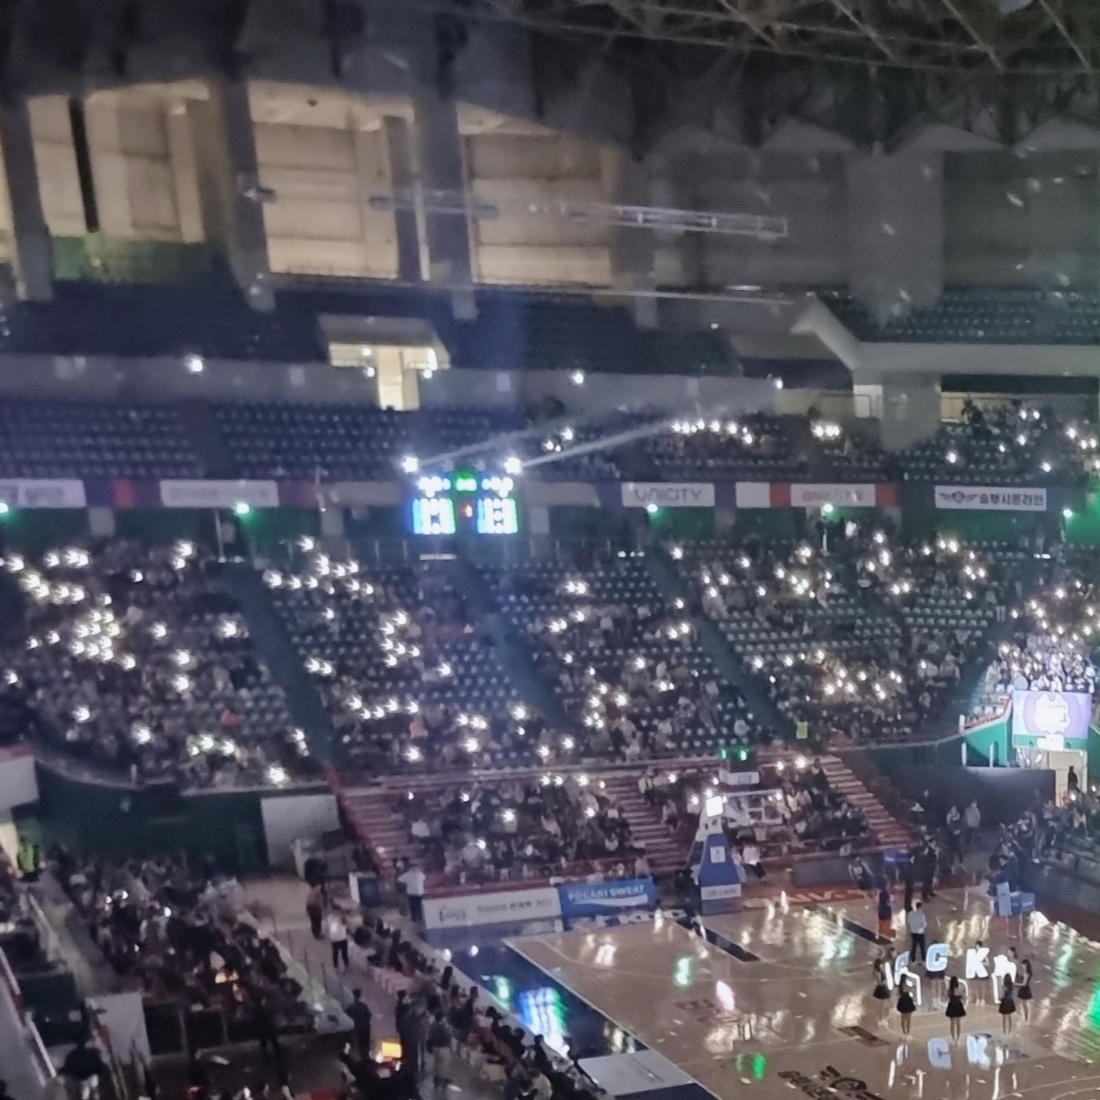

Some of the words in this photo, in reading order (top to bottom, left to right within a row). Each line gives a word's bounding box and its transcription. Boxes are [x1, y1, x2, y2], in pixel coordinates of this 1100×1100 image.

[634, 487, 702, 502] UNICITY
[567, 889, 608, 902] POCARI
[609, 884, 645, 898] SWEAT
